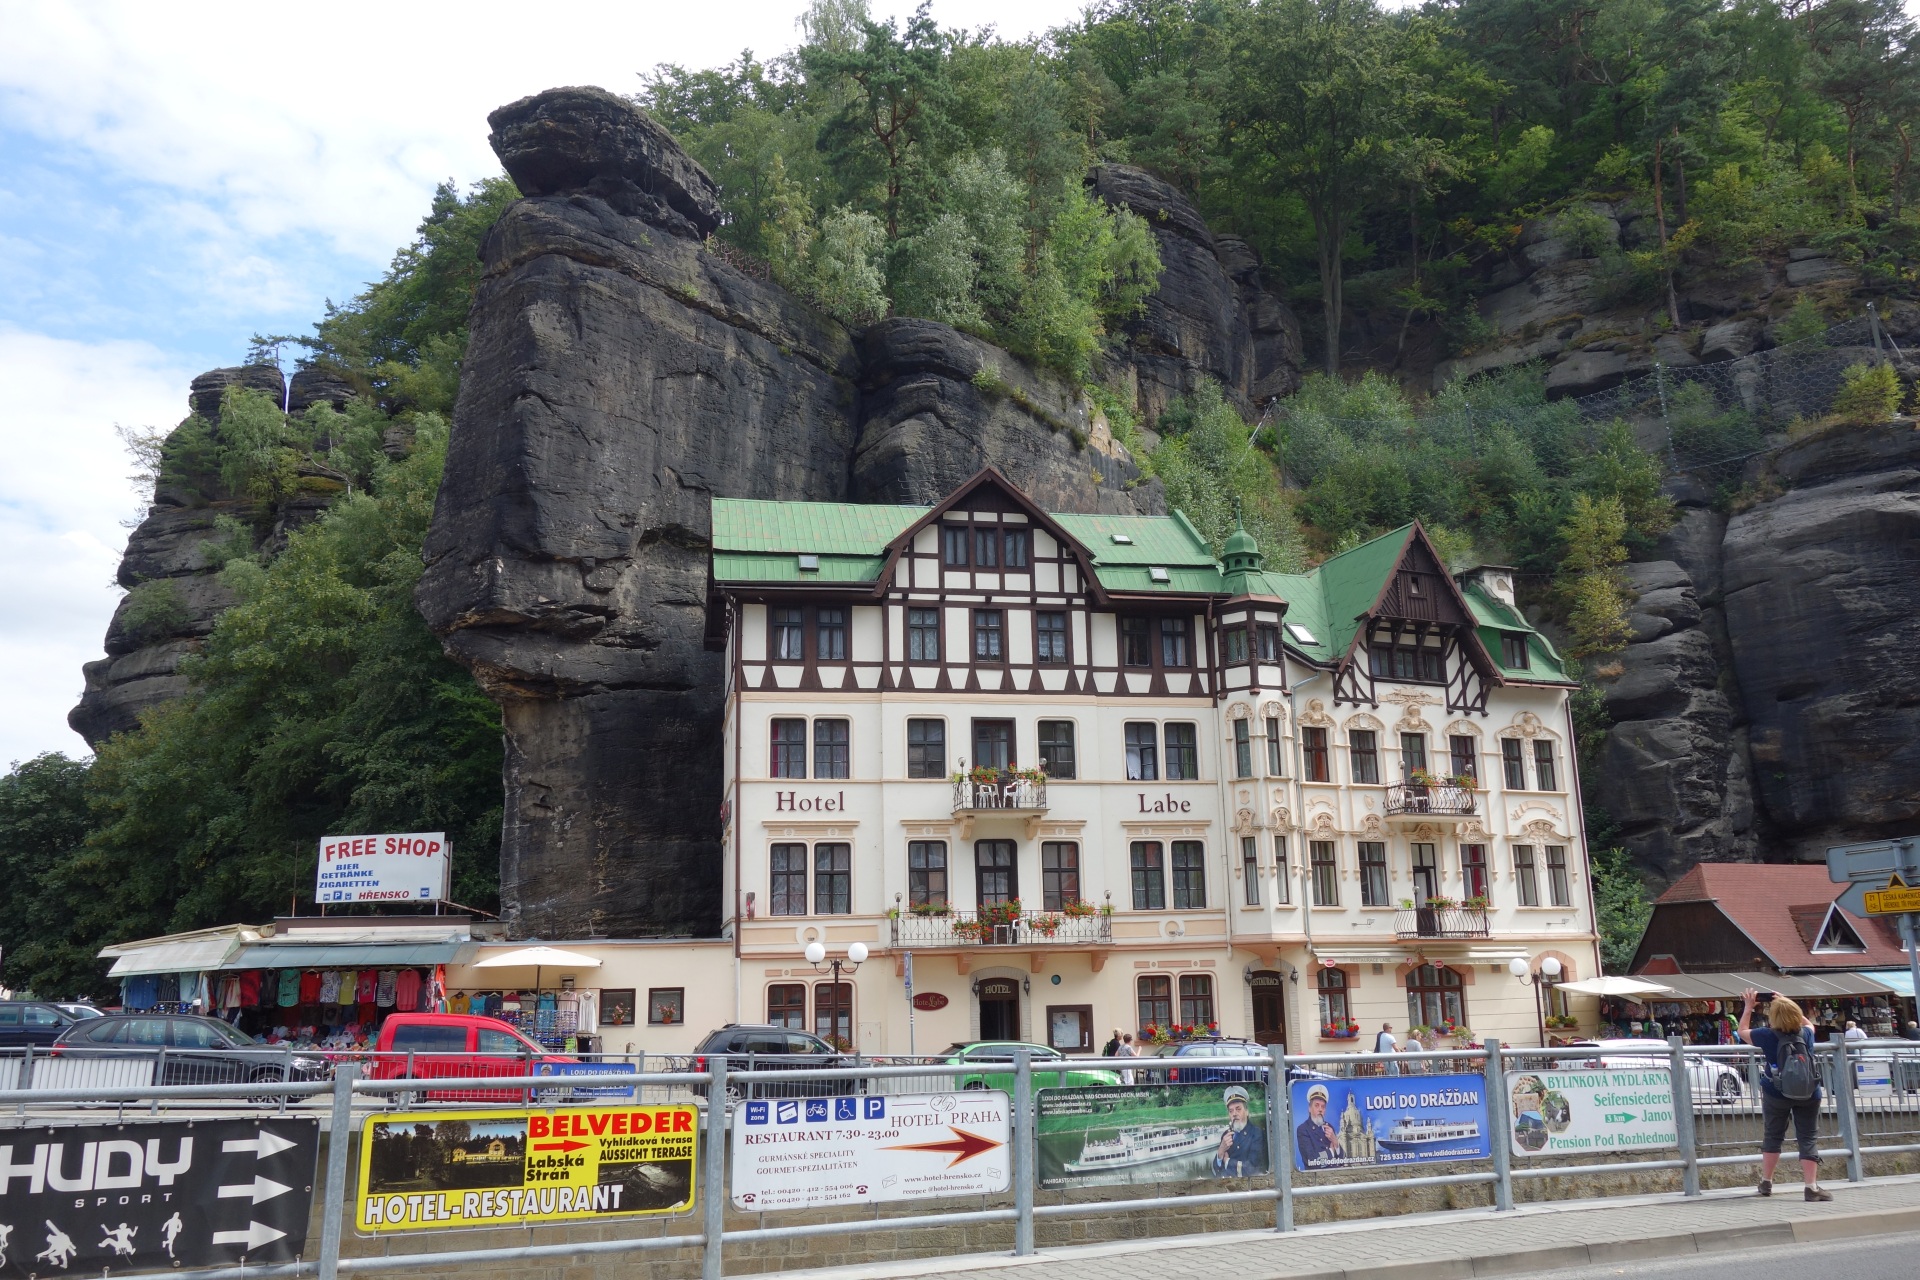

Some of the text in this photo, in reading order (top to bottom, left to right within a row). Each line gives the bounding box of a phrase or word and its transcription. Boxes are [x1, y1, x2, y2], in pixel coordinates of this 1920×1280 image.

[776, 791, 1191, 813] Hotel Labe
[325, 838, 440, 862] FREE SHOP
[321, 870, 374, 879] GETRÄNKE
[336, 863, 359, 871] BIER
[318, 880, 380, 889] ZIGARETTEN
[358, 890, 410, 900] HŘENSKO
[984, 984, 1011, 994] HOTEL
[1251, 977, 1280, 986] ESTAURACE
[1547, 1070, 1670, 1088] BYLINKOVÁ MÝDLÁRNA
[1365, 1088, 1479, 1110] LODÍ DO DRÁŽĎAN
[1594, 1090, 1672, 1107] Seifensiederei
[869, 1100, 882, 1118] P
[1641, 1109, 1673, 1123] Janov
[529, 1110, 693, 1139] BELVEDER
[891, 1110, 1002, 1128] HOTEL PRAHA
[1606, 1113, 1626, 1123] 3 km
[599, 1136, 693, 1149] Vyhlídková terasa
[745, 1130, 833, 1145] RESTAURANT
[1549, 1131, 1676, 1149] Pension Pod Rozhlednou
[599, 1146, 693, 1162] AUSSICHT TERRASE
[758, 1149, 856, 1163] GURMÁNSKÉ SPECIALITY
[1419, 1148, 1481, 1158] www.lodidodrazdan.cz
[0, 1136, 194, 1195] HUDY
[527, 1154, 585, 1169] Labská
[756, 1161, 858, 1175] GOURMET-SPEZIALITÄTEN
[526, 1168, 570, 1182] Stráň
[904, 1172, 982, 1183] www.hotel-hrensko.cz
[74, 1193, 173, 1209] SPORT
[365, 1184, 624, 1225] HOTEL-RESTAURANT
